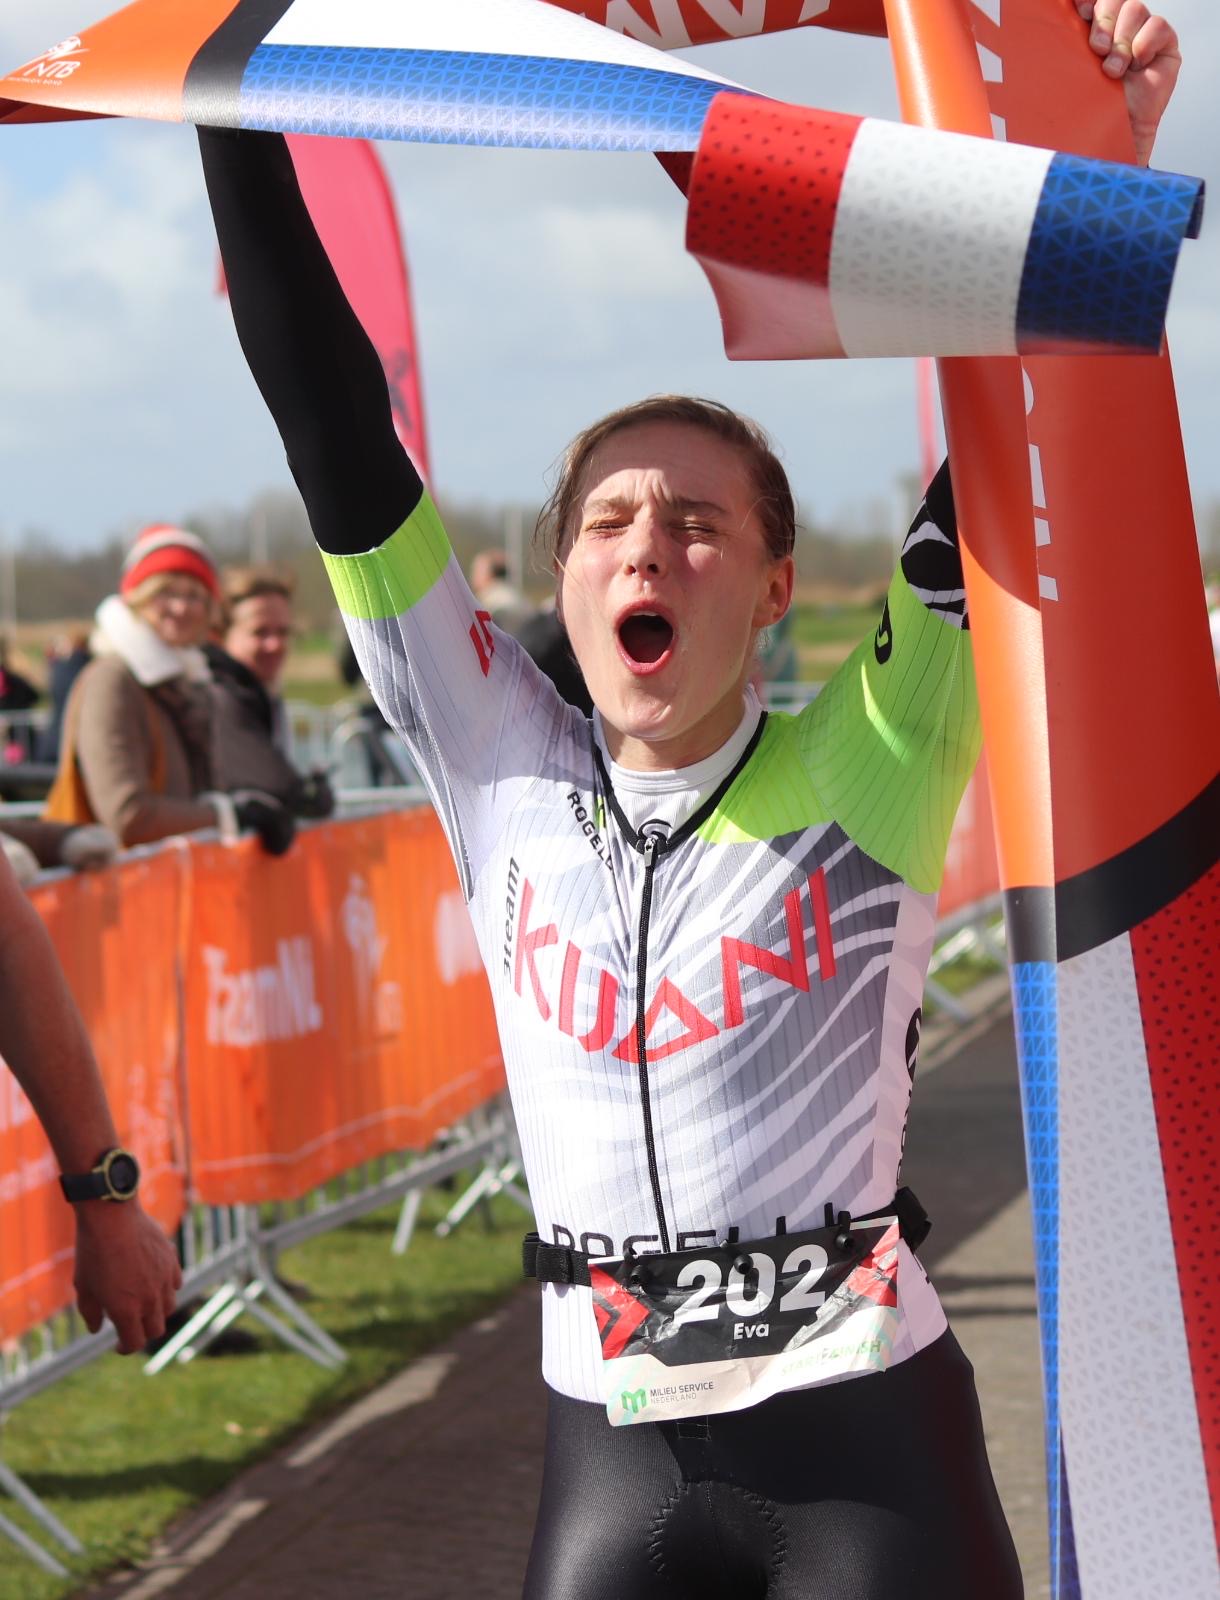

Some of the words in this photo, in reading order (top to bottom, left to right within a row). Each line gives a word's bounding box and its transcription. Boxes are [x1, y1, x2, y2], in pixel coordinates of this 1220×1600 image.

[23, 61, 81, 79] NTB
[566, 791, 613, 871] ROGELL
[673, 1244, 829, 1325] 202
[733, 1322, 770, 1340] Eva
[650, 1386, 677, 1398] MILIEU
[678, 1381, 714, 1394] SERVICE
[650, 1392, 697, 1405] NEDERLAND
